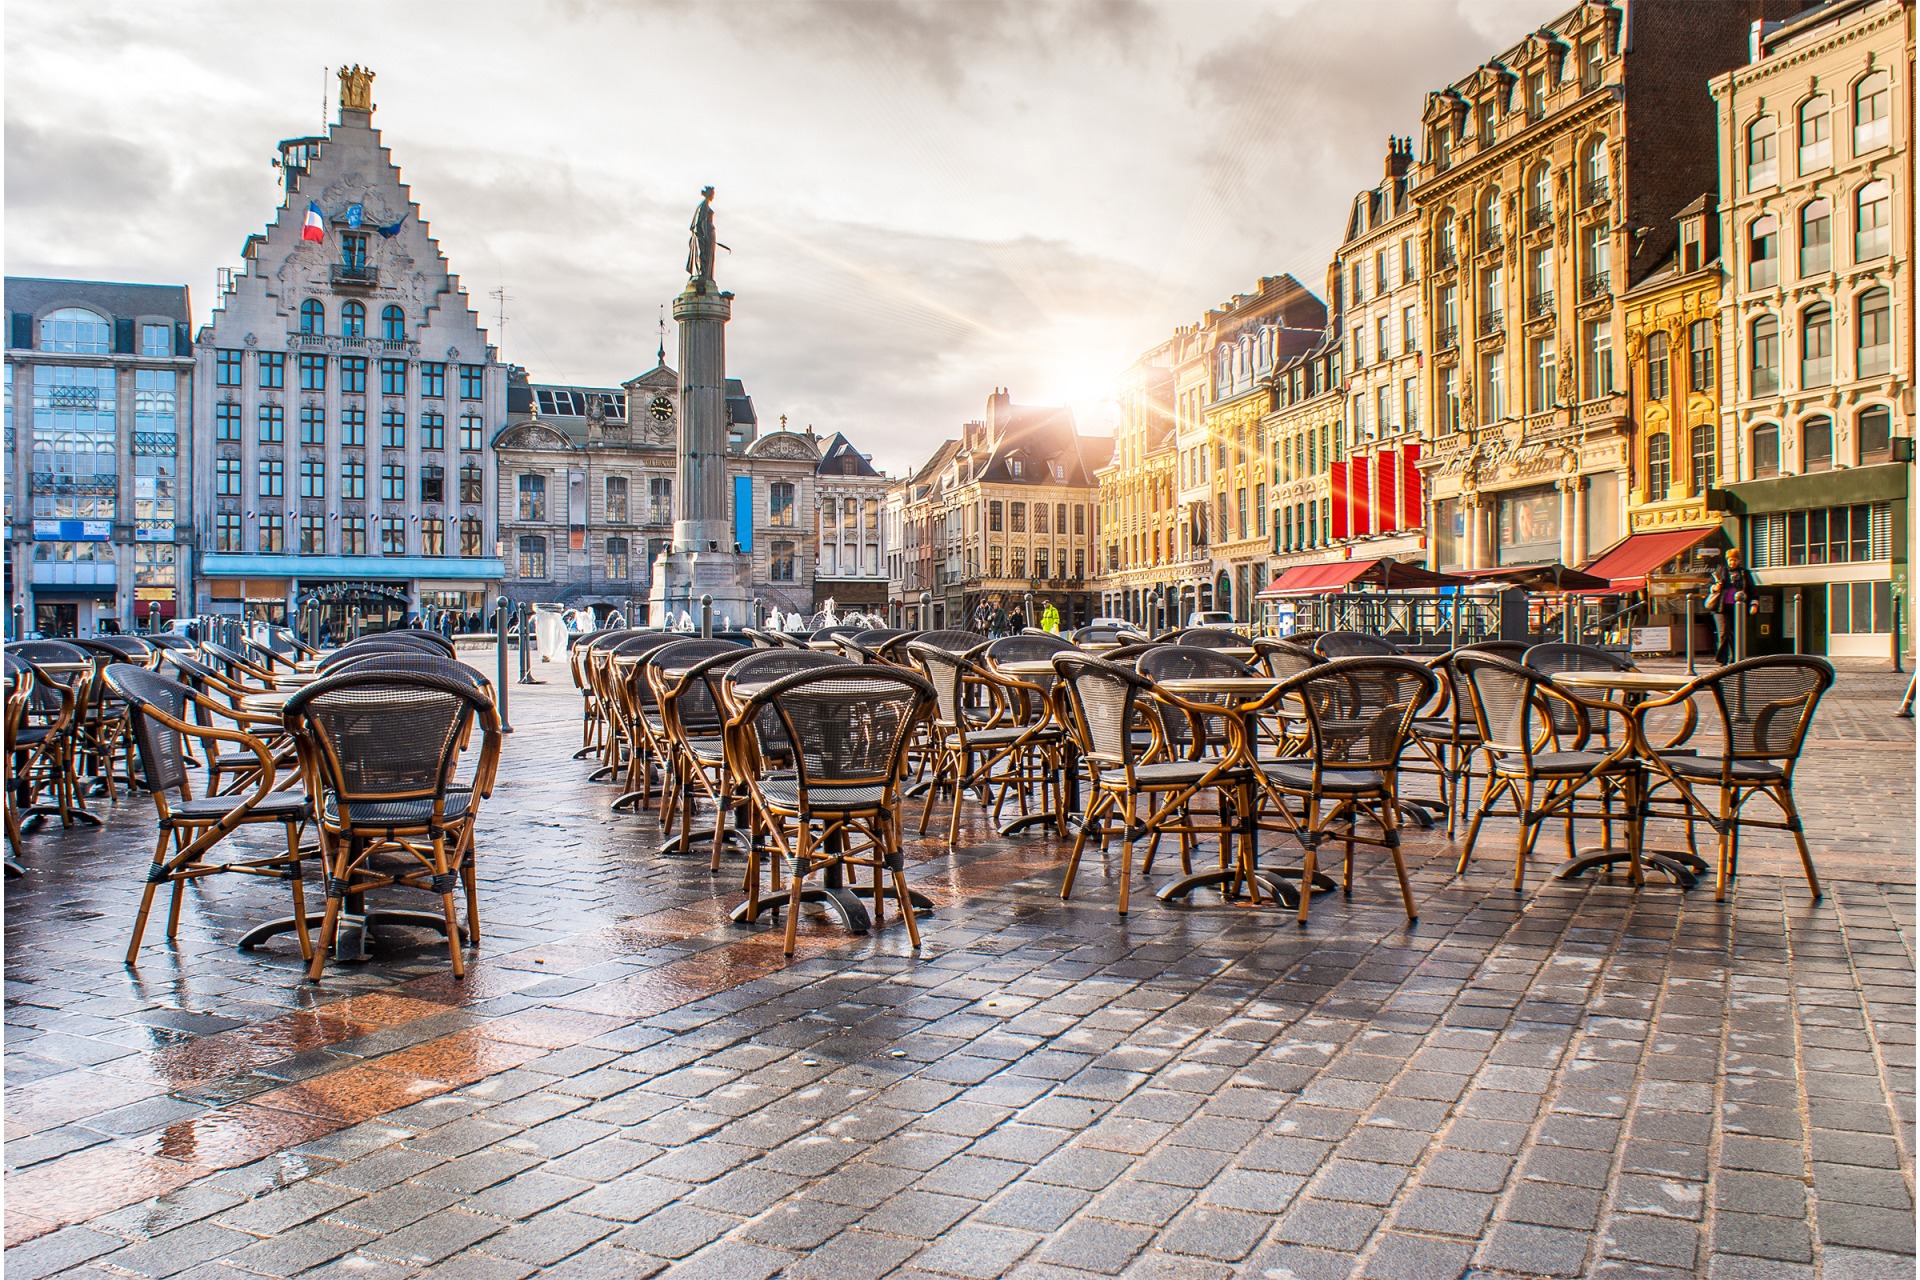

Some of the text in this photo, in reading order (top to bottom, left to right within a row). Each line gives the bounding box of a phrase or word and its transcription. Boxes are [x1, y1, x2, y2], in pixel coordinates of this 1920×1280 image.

[1437, 435, 1546, 476] Hotel Bellevue
[363, 581, 402, 599] PLACE
